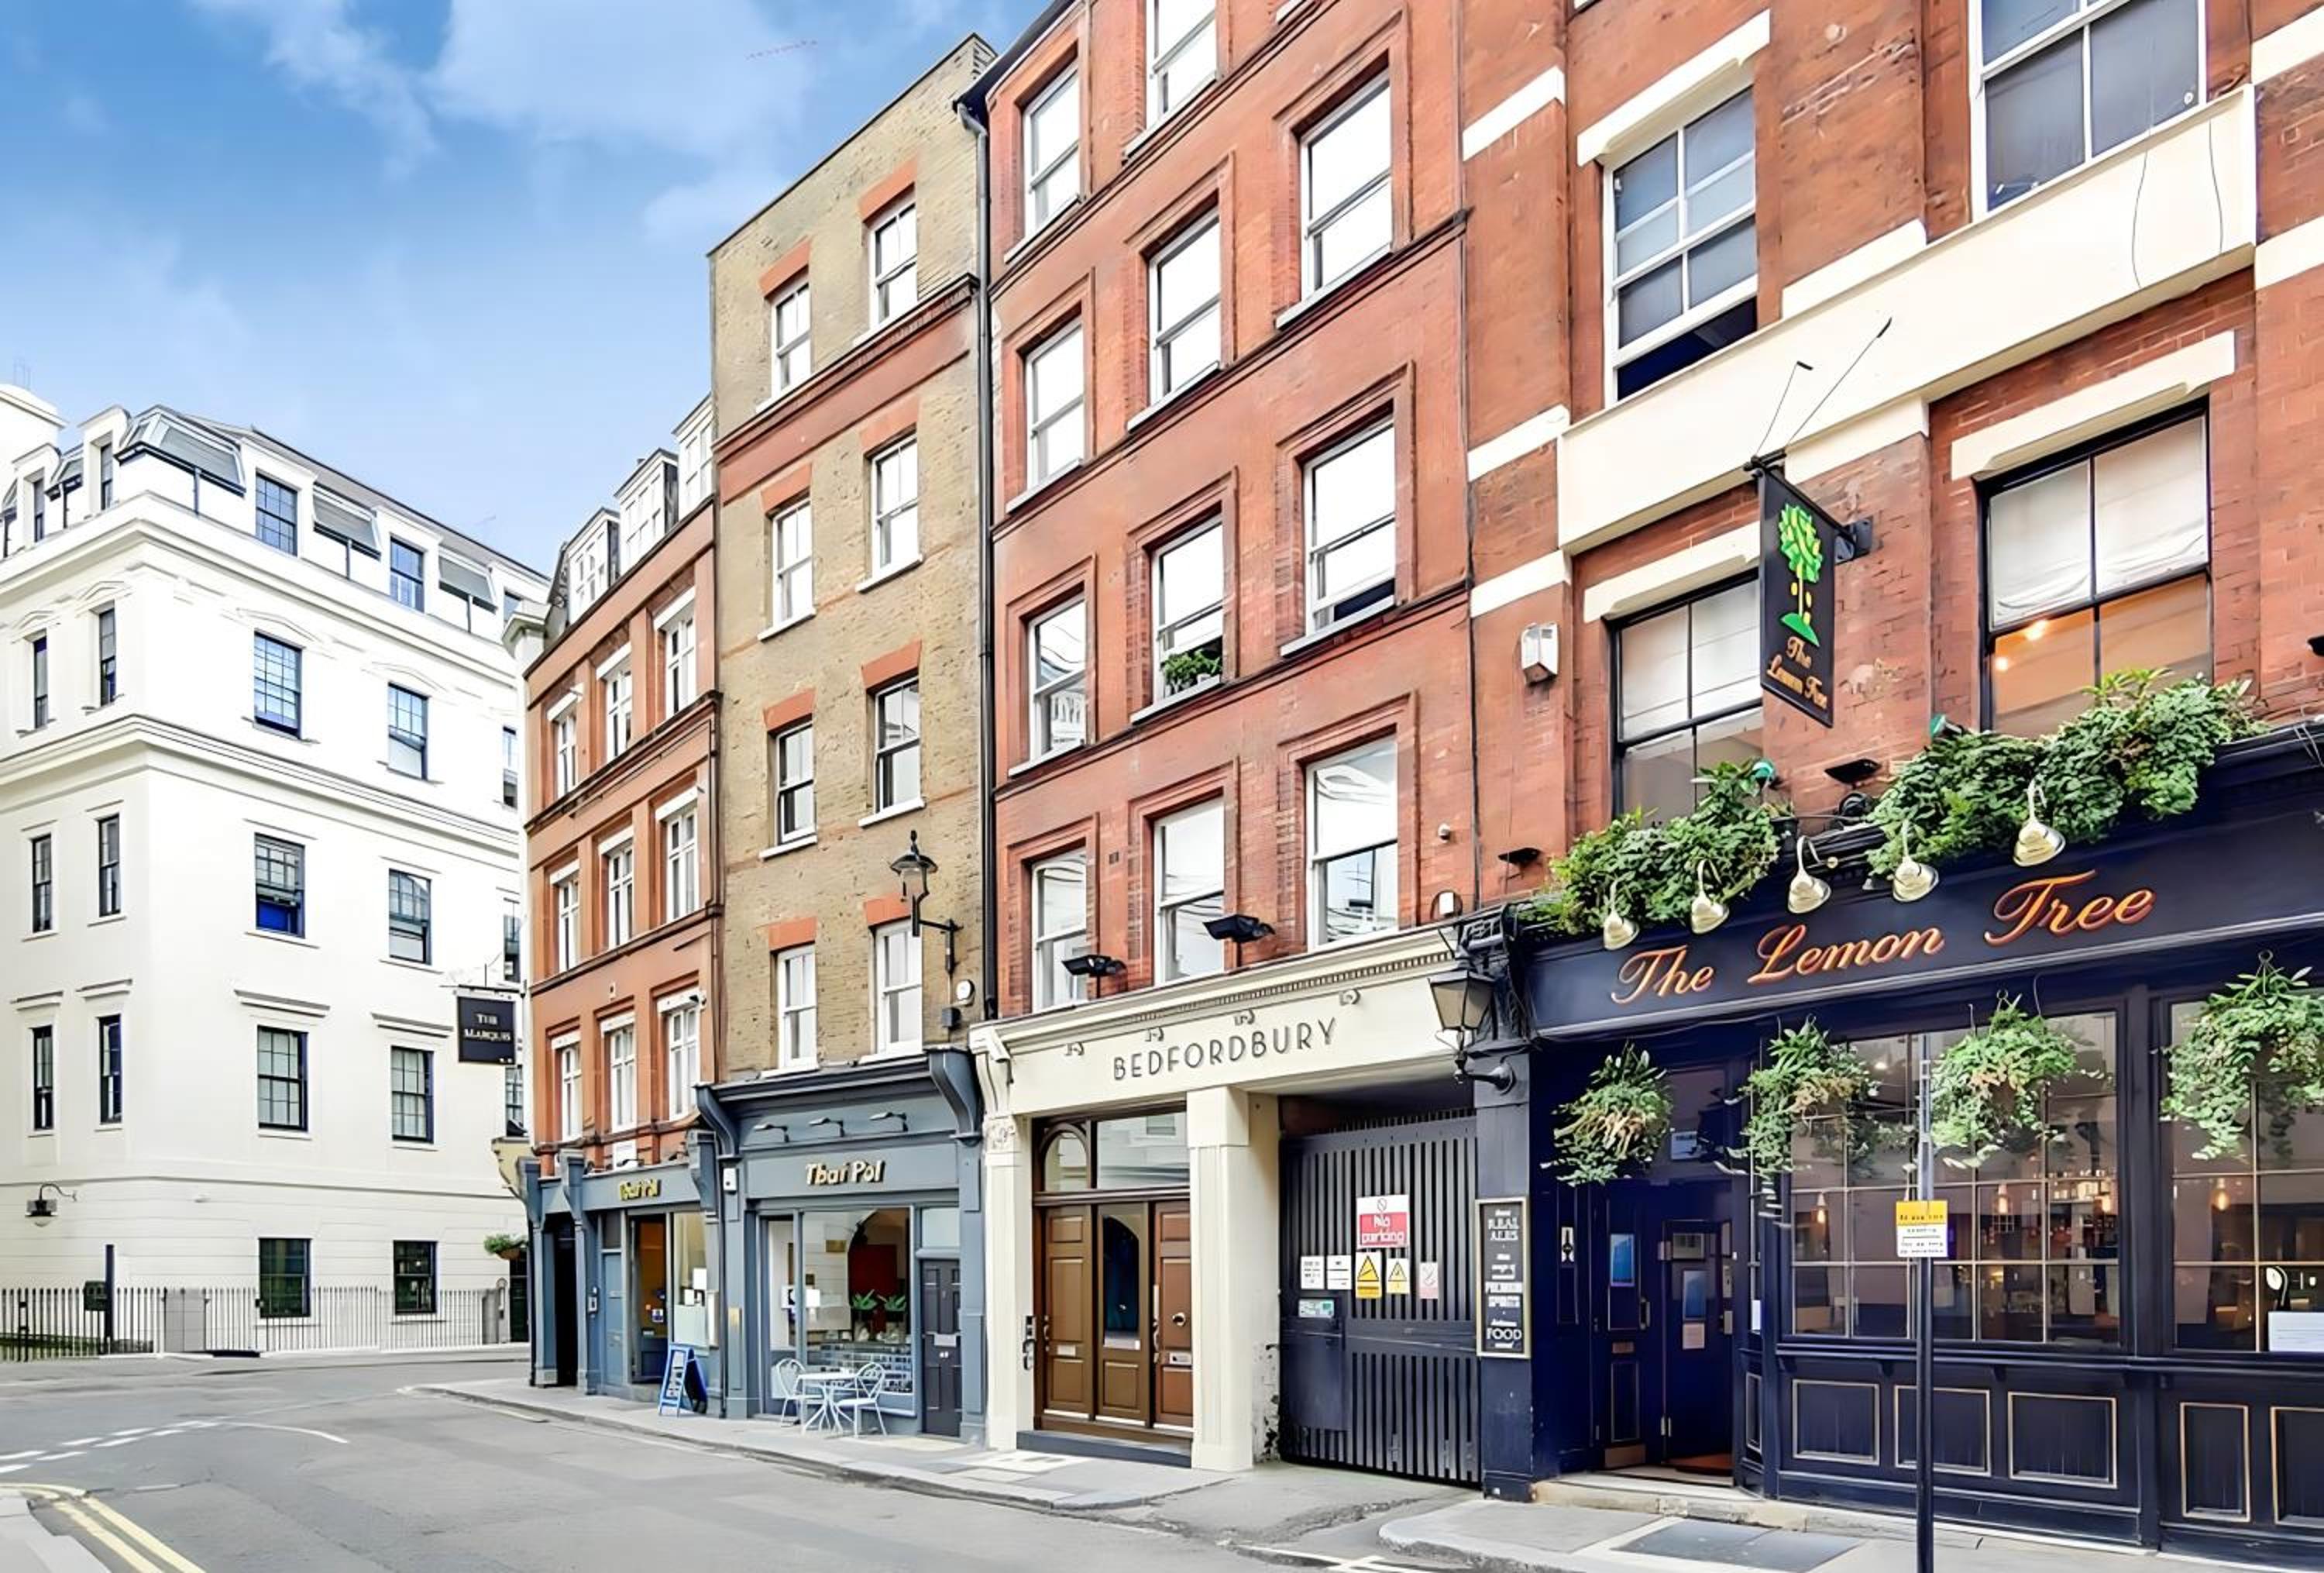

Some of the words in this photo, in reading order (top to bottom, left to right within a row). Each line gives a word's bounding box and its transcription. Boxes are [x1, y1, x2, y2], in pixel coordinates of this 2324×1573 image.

[1786, 636, 1812, 669] The
[1767, 654, 1803, 695] Lemon
[1804, 676, 1827, 710] Tree
[1611, 944, 1714, 1004] The
[1747, 924, 1946, 984] Lemon
[1984, 868, 2156, 947] Tree
[1113, 1017, 1336, 1081] BEDFORDBURY
[1486, 1327, 1522, 1340] FOOD
